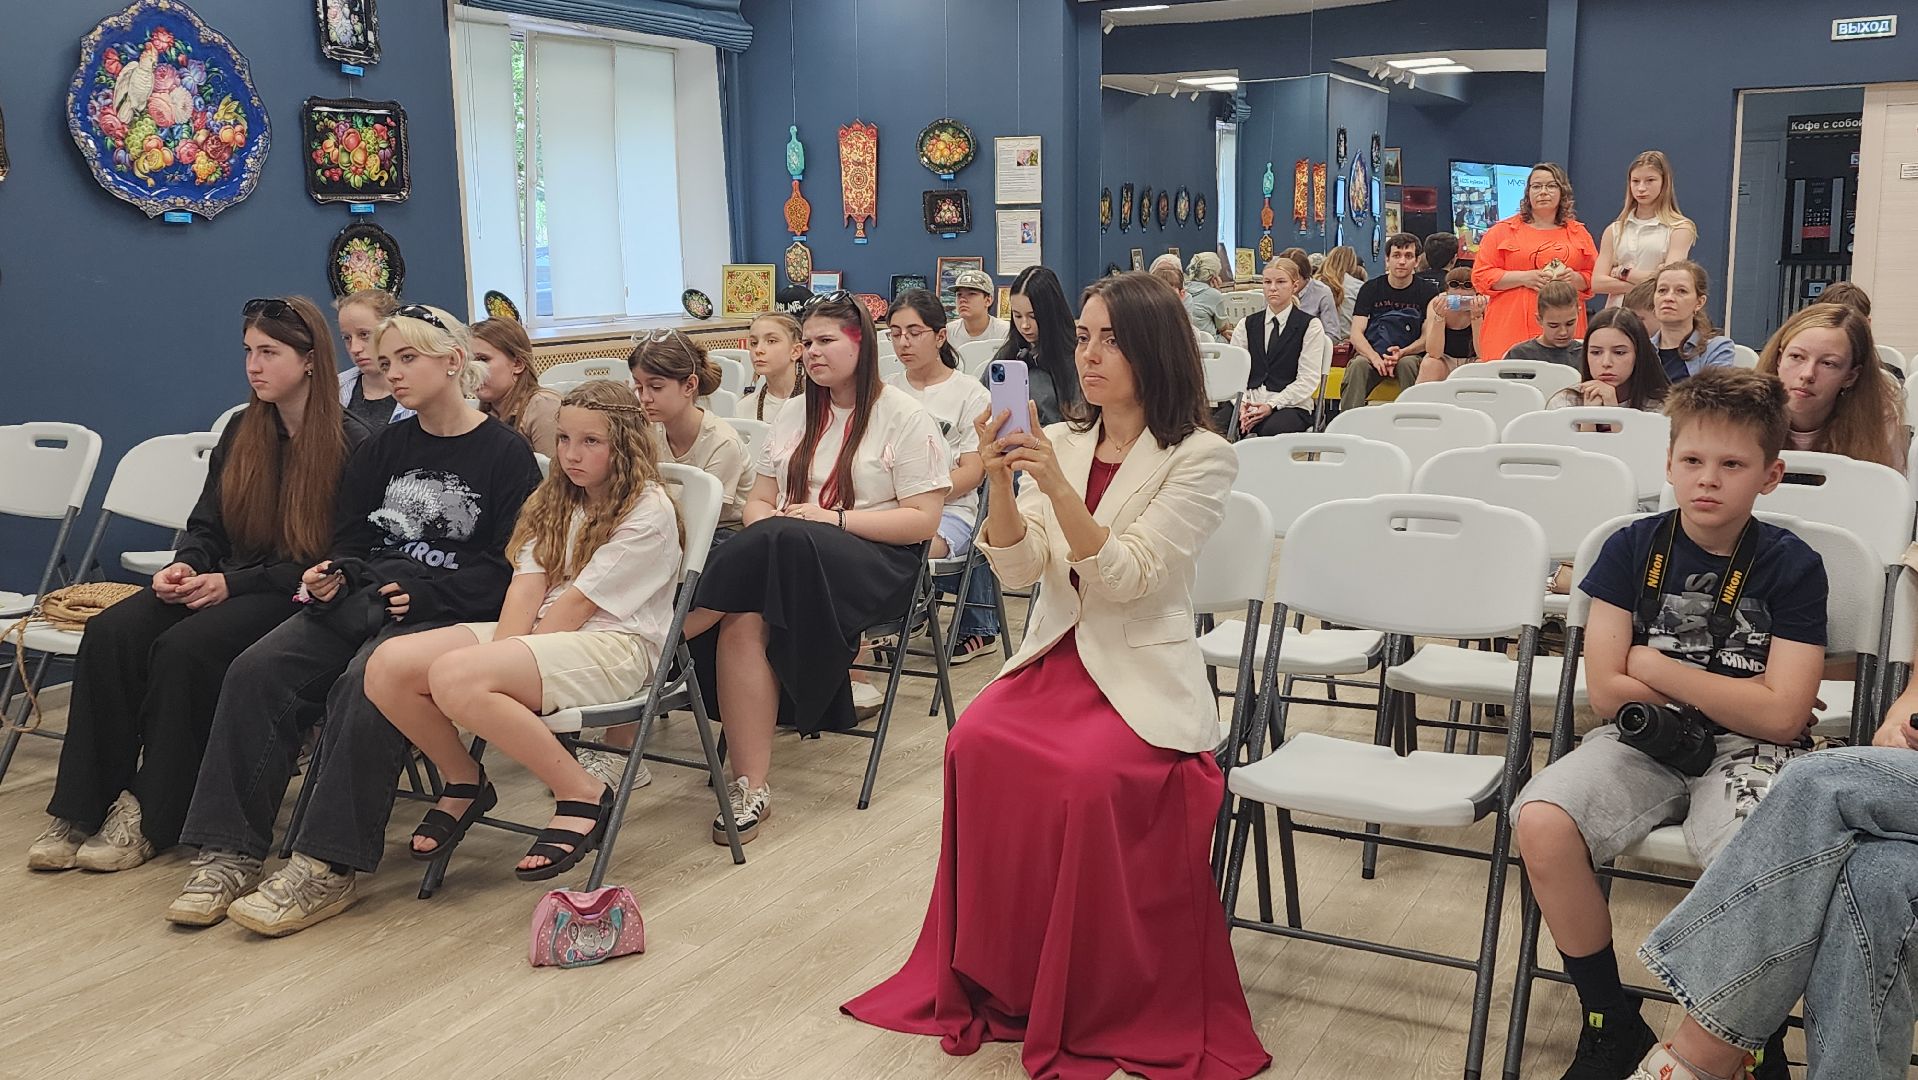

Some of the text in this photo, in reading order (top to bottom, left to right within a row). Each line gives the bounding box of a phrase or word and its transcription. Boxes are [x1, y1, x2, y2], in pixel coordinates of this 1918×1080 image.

[1838, 20, 1889, 34] ВЫХОД
[1791, 120, 1820, 131] Кофе
[1823, 121, 1830, 129] с
[1646, 553, 1664, 589] Nikon
[1721, 570, 1743, 605] Nikon
[1721, 655, 1766, 672] MIND
